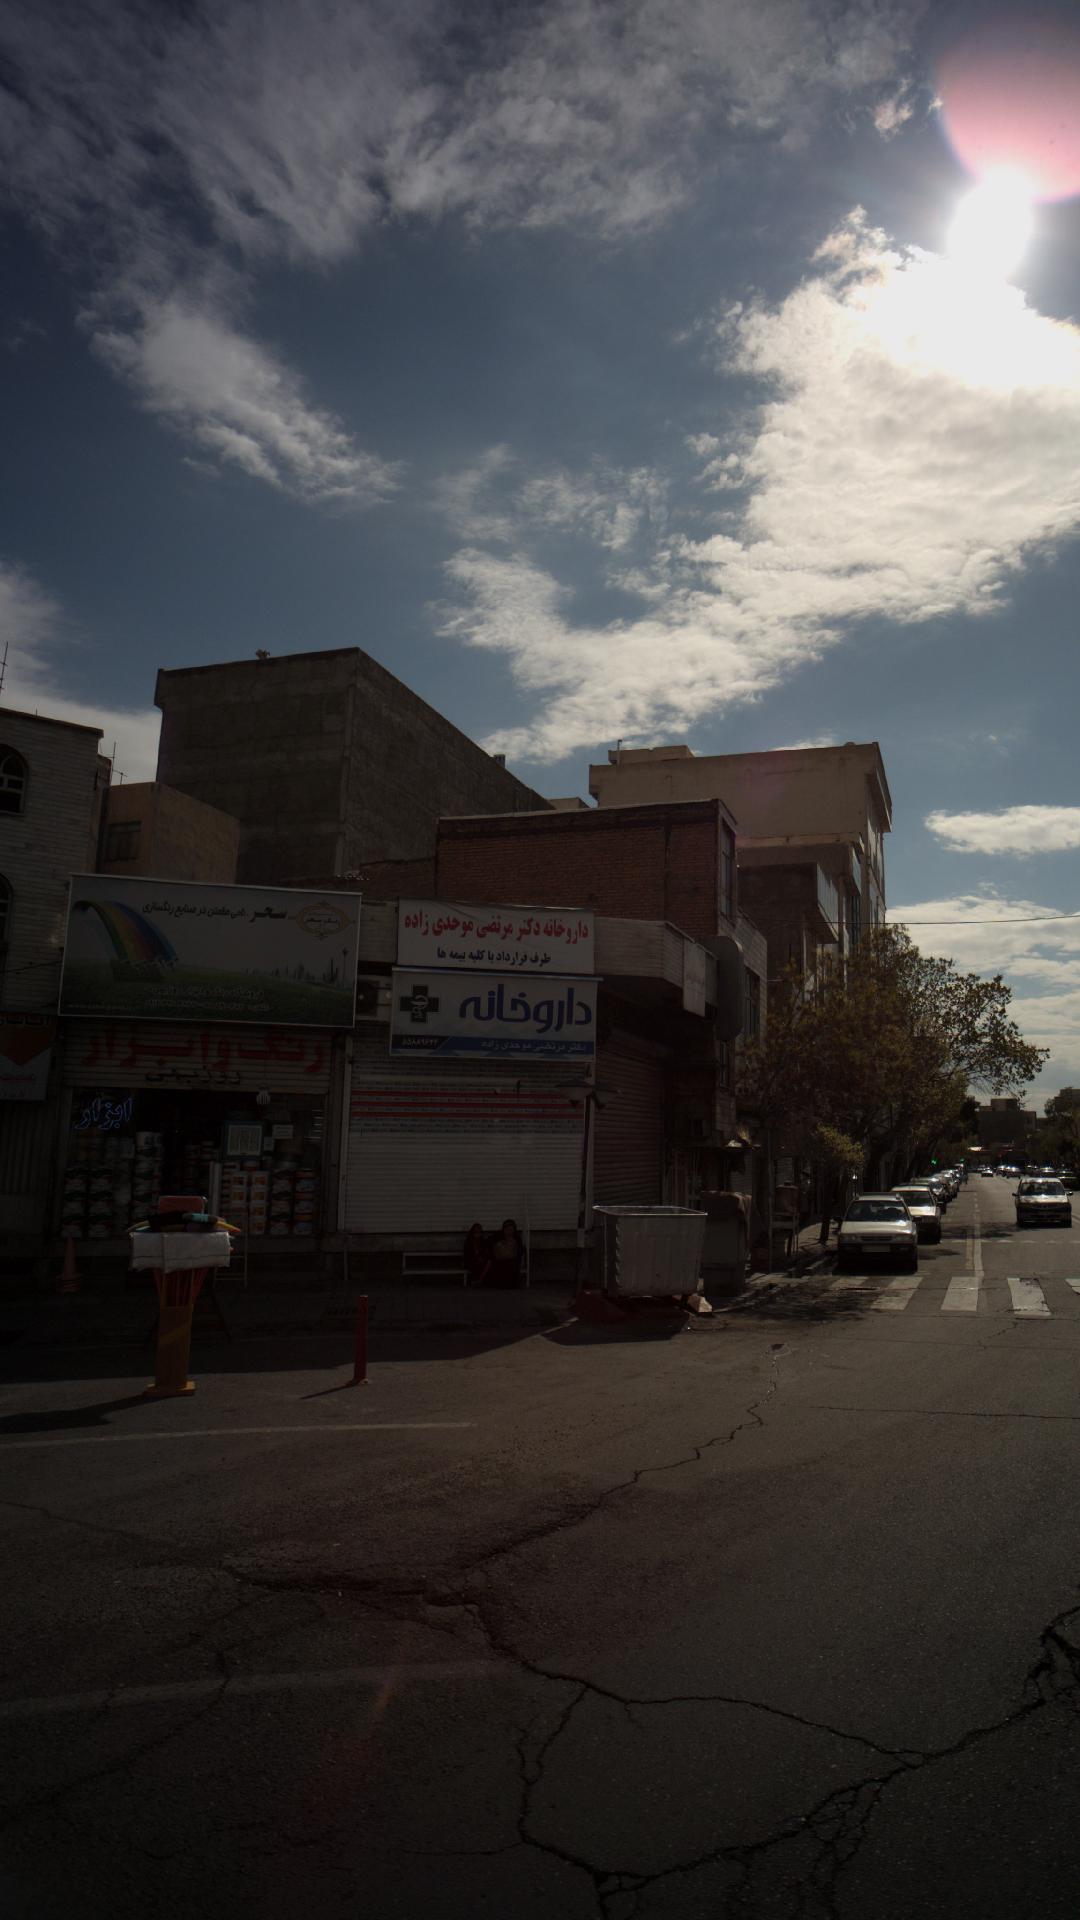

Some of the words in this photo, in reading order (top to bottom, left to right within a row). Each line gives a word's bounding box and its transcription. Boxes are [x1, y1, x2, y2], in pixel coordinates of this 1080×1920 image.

[404, 910, 429, 936] زاده
[432, 916, 474, 938] موحدی
[477, 914, 513, 939] مرتضی
[517, 917, 540, 941] دکتر
[544, 919, 588, 944] داروخانه
[437, 946, 446, 959] ها
[449, 950, 466, 961] بیمه
[468, 948, 485, 961] کلیه
[488, 950, 496, 961] با
[496, 950, 528, 966] قرارداد
[530, 951, 552, 967] طرف
[459, 983, 592, 1034] داروخانه
[81, 1024, 210, 1069] ابزار
[212, 1037, 231, 1071] و
[238, 1031, 325, 1073] رنگ
